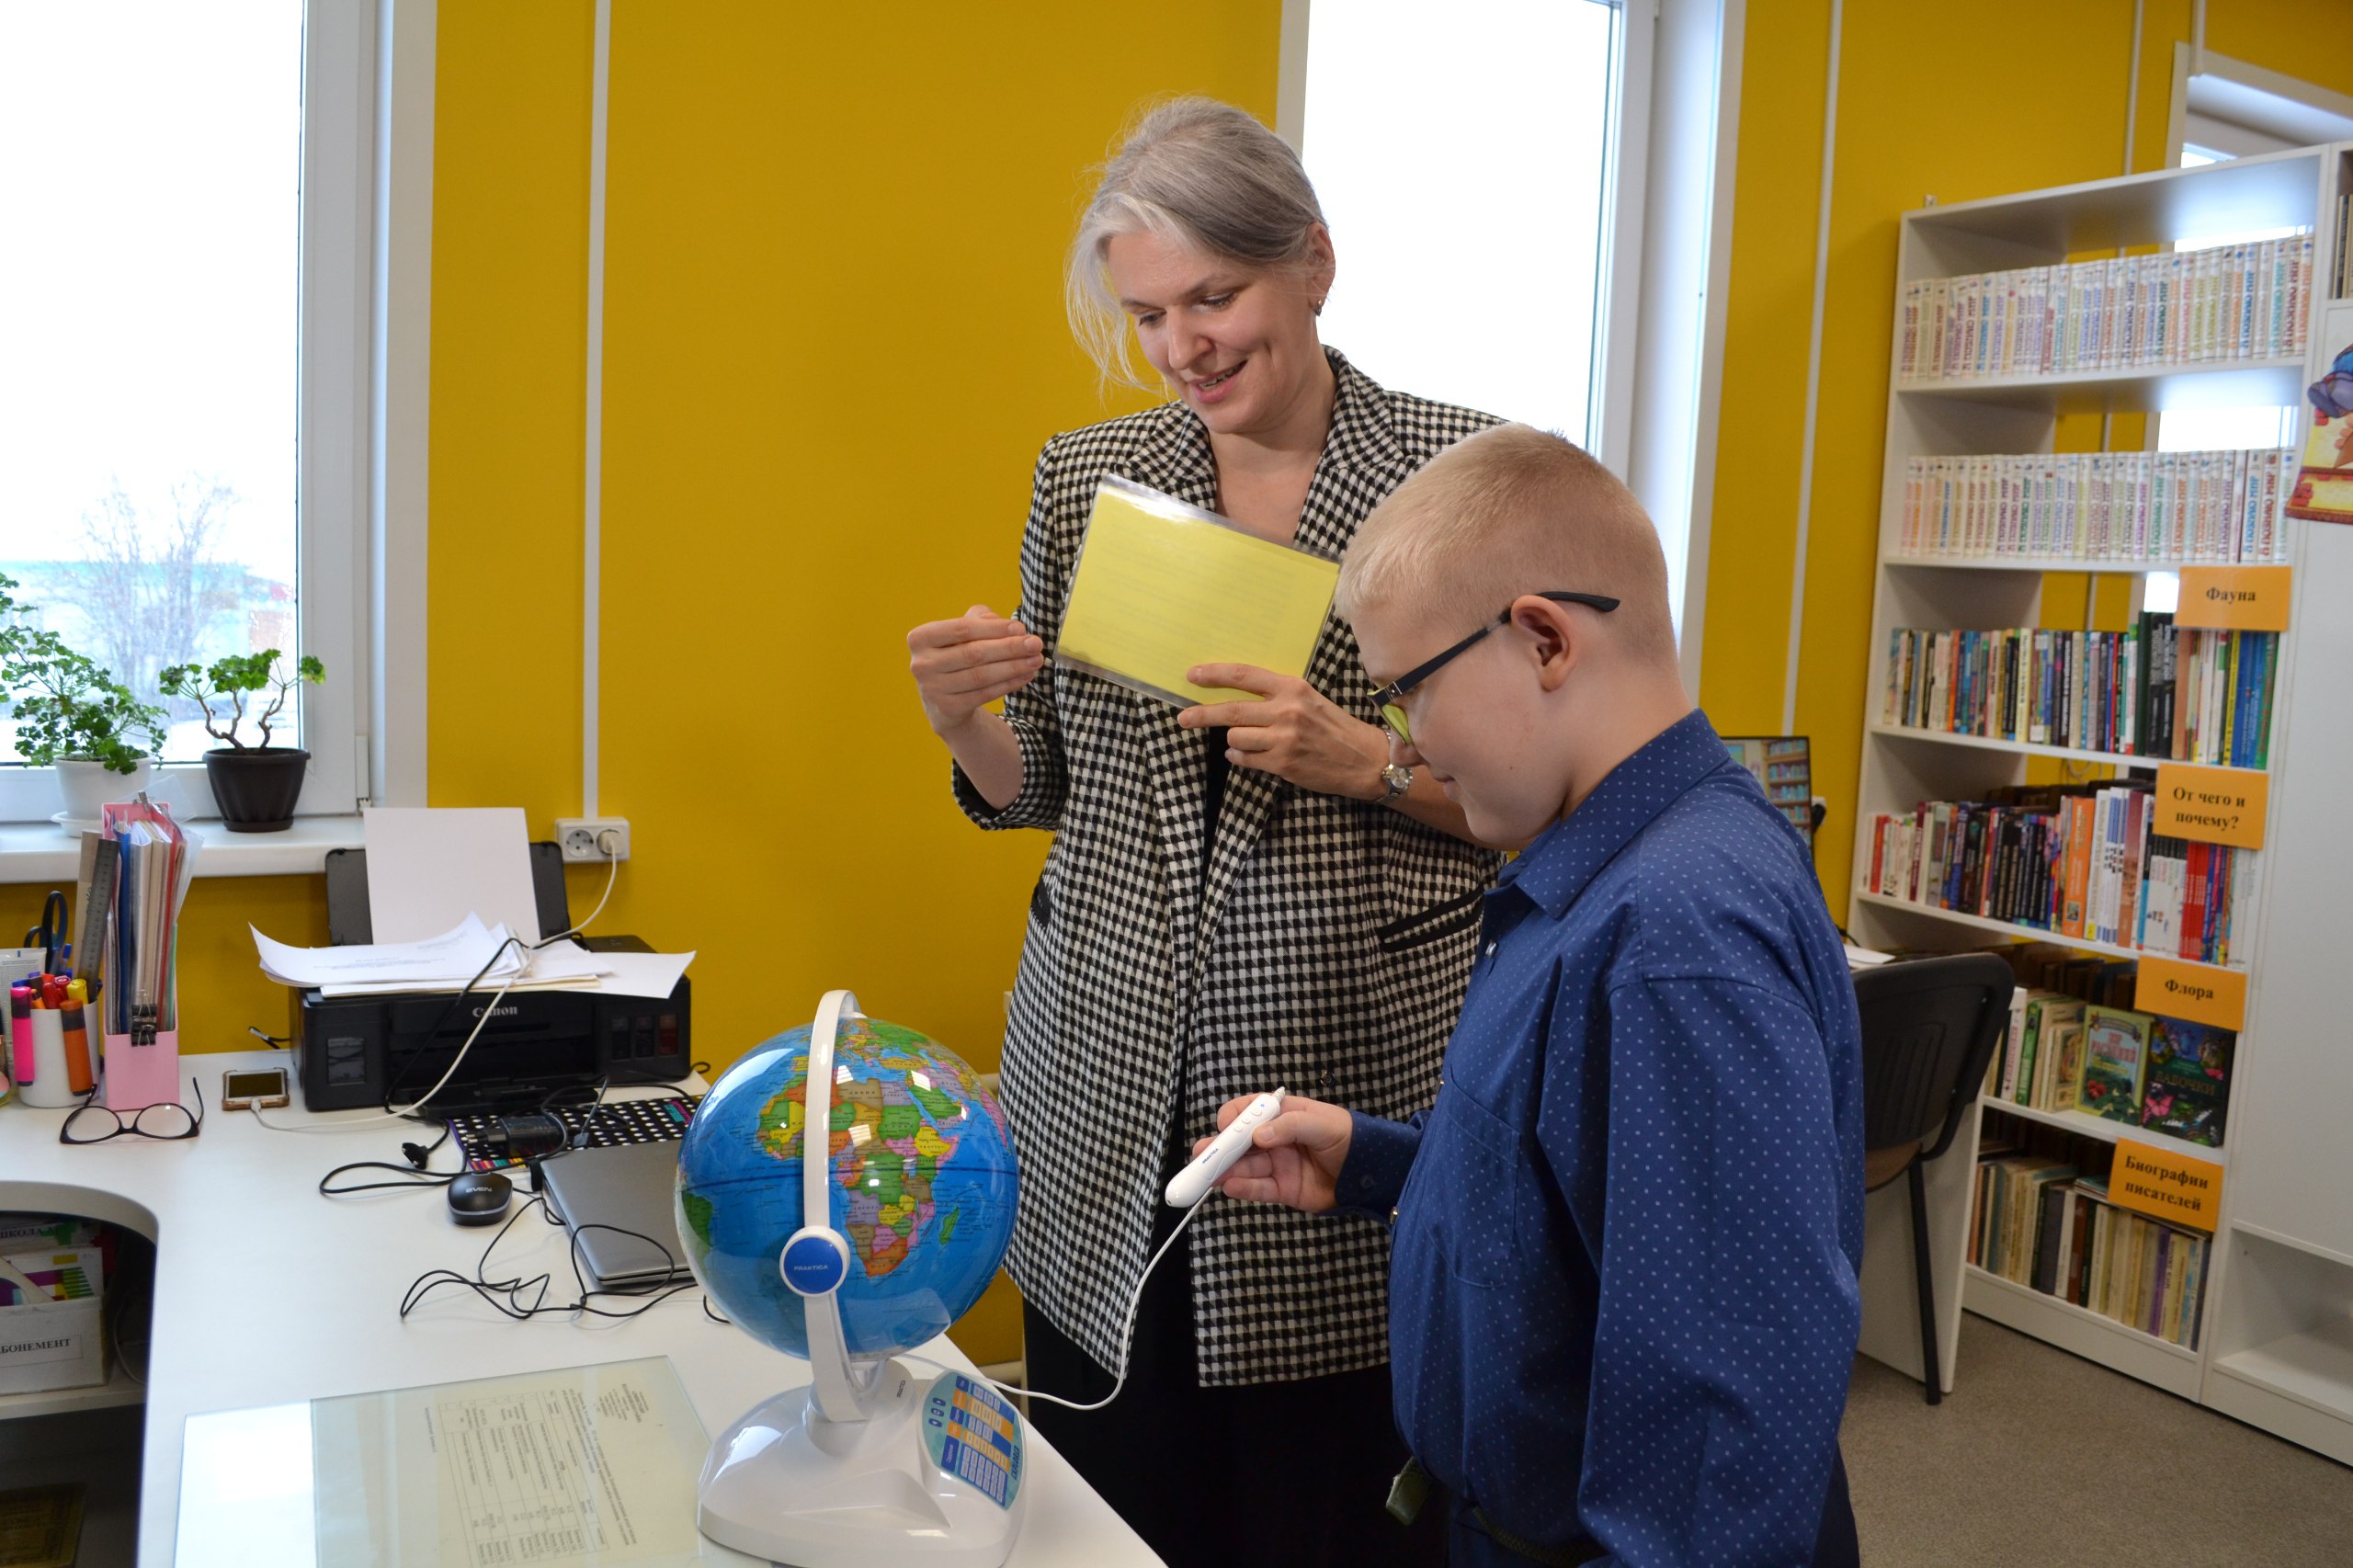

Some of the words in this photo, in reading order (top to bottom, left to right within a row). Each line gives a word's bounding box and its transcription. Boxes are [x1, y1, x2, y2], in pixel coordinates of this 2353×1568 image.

[2206, 586, 2256, 605] Фауна
[2174, 787, 2193, 801] От
[2199, 792, 2231, 806] чего
[2236, 797, 2245, 807] и
[2176, 812, 2239, 831] почему?
[2165, 979, 2213, 1000] Флора
[472, 1006, 517, 1017] Cnon
[2125, 1155, 2209, 1189] Биографии
[2125, 1181, 2201, 1211] писателей
[0, 1338, 72, 1354] БОНЕМЕНТ
